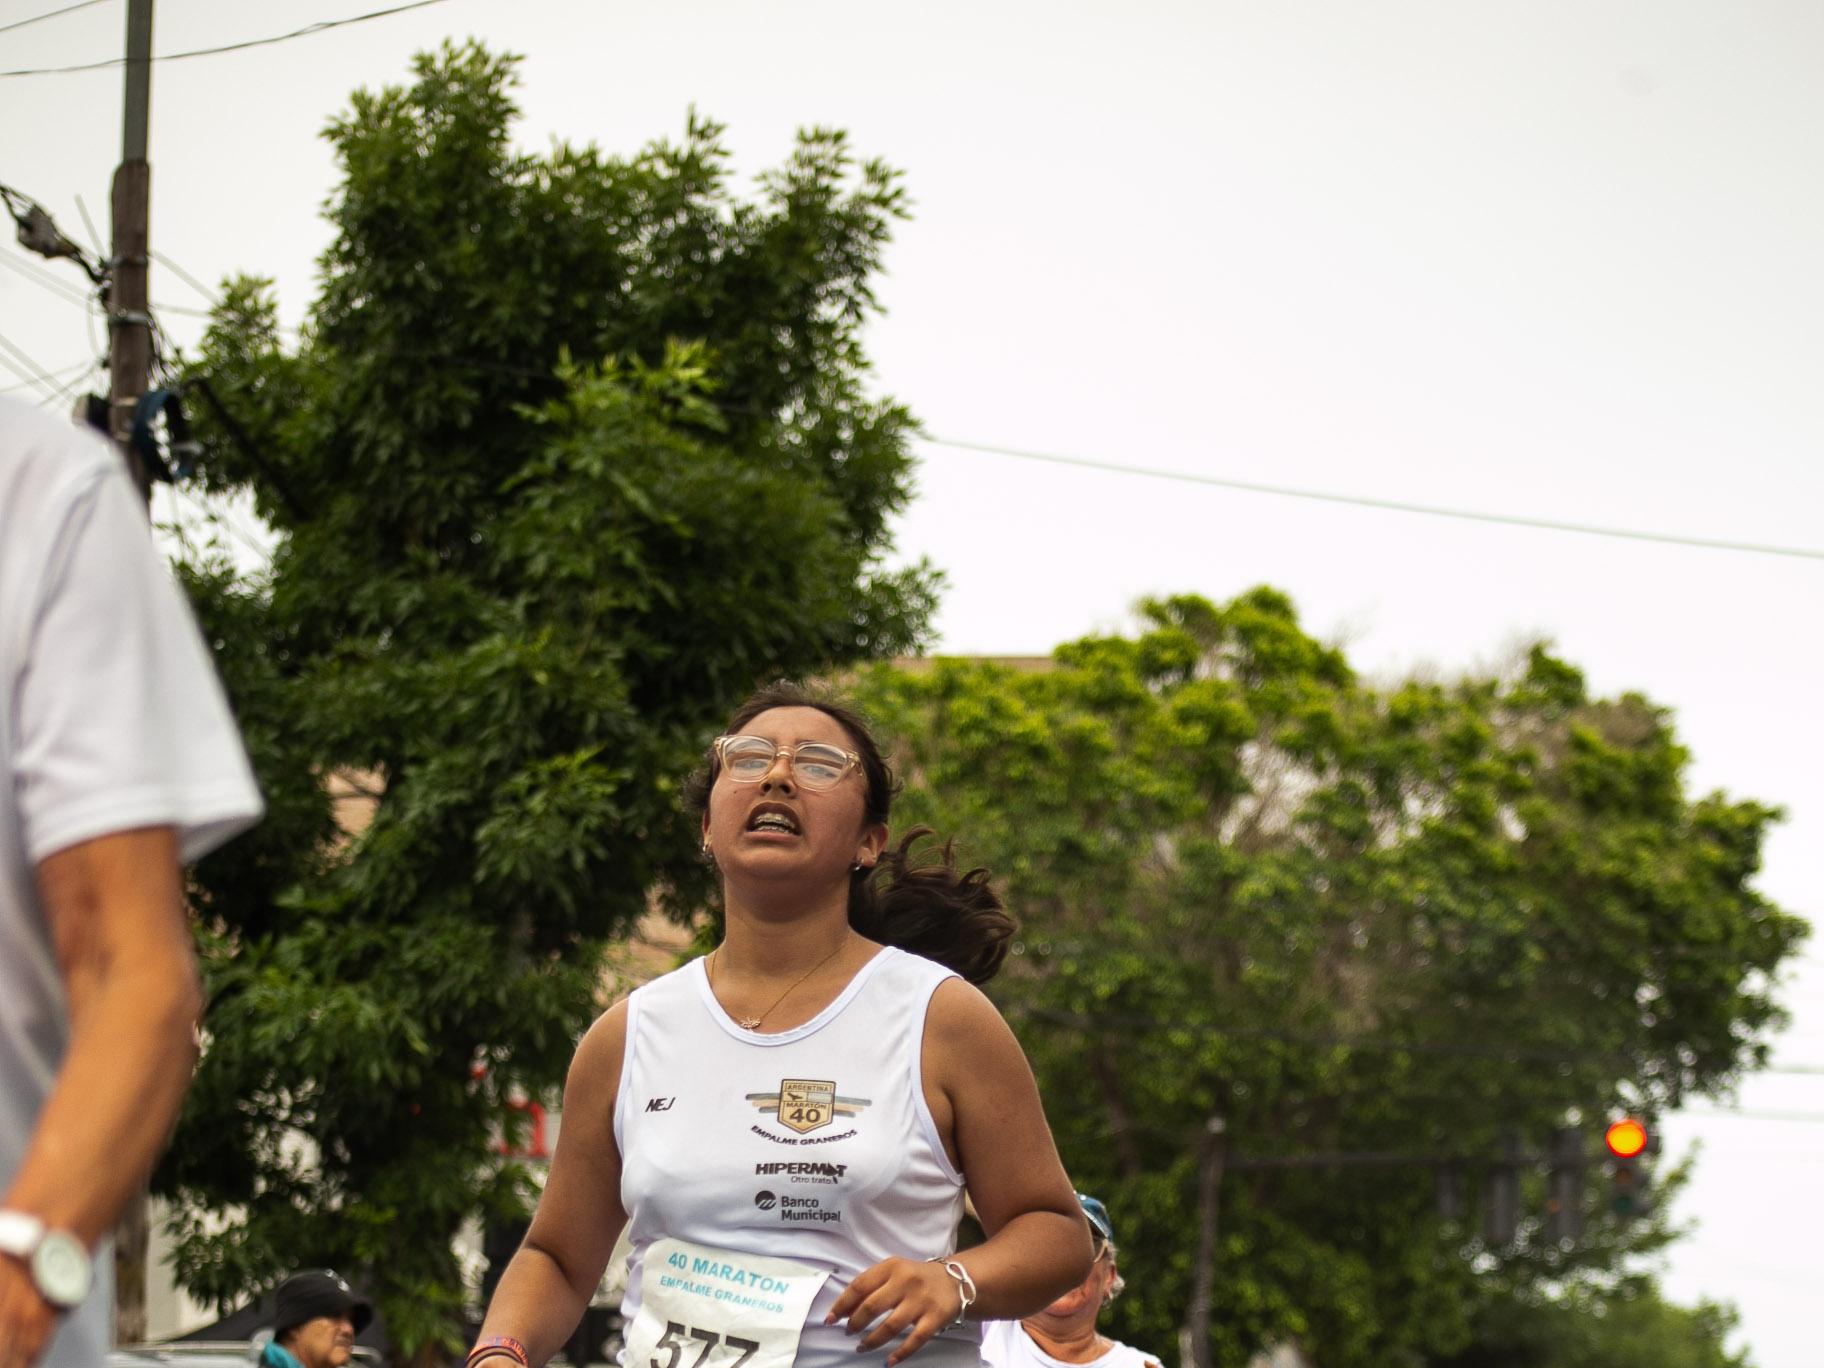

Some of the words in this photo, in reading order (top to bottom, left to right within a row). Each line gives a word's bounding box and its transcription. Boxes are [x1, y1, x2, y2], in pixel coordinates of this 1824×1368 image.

[788, 1084, 829, 1092] ARGENTINA
[645, 1097, 676, 1113] NEJ
[789, 1108, 821, 1124] 40
[750, 1124, 798, 1146] EMPALME
[800, 1129, 858, 1146] GRANEROS
[791, 1176, 810, 1184] Otro
[781, 1196, 819, 1208] Banco
[781, 1209, 841, 1223] Municipal
[668, 1252, 688, 1271] 40
[692, 1257, 790, 1296] MARATON
[660, 1275, 712, 1297] EMPALME
[714, 1289, 784, 1314] GRANEROS
